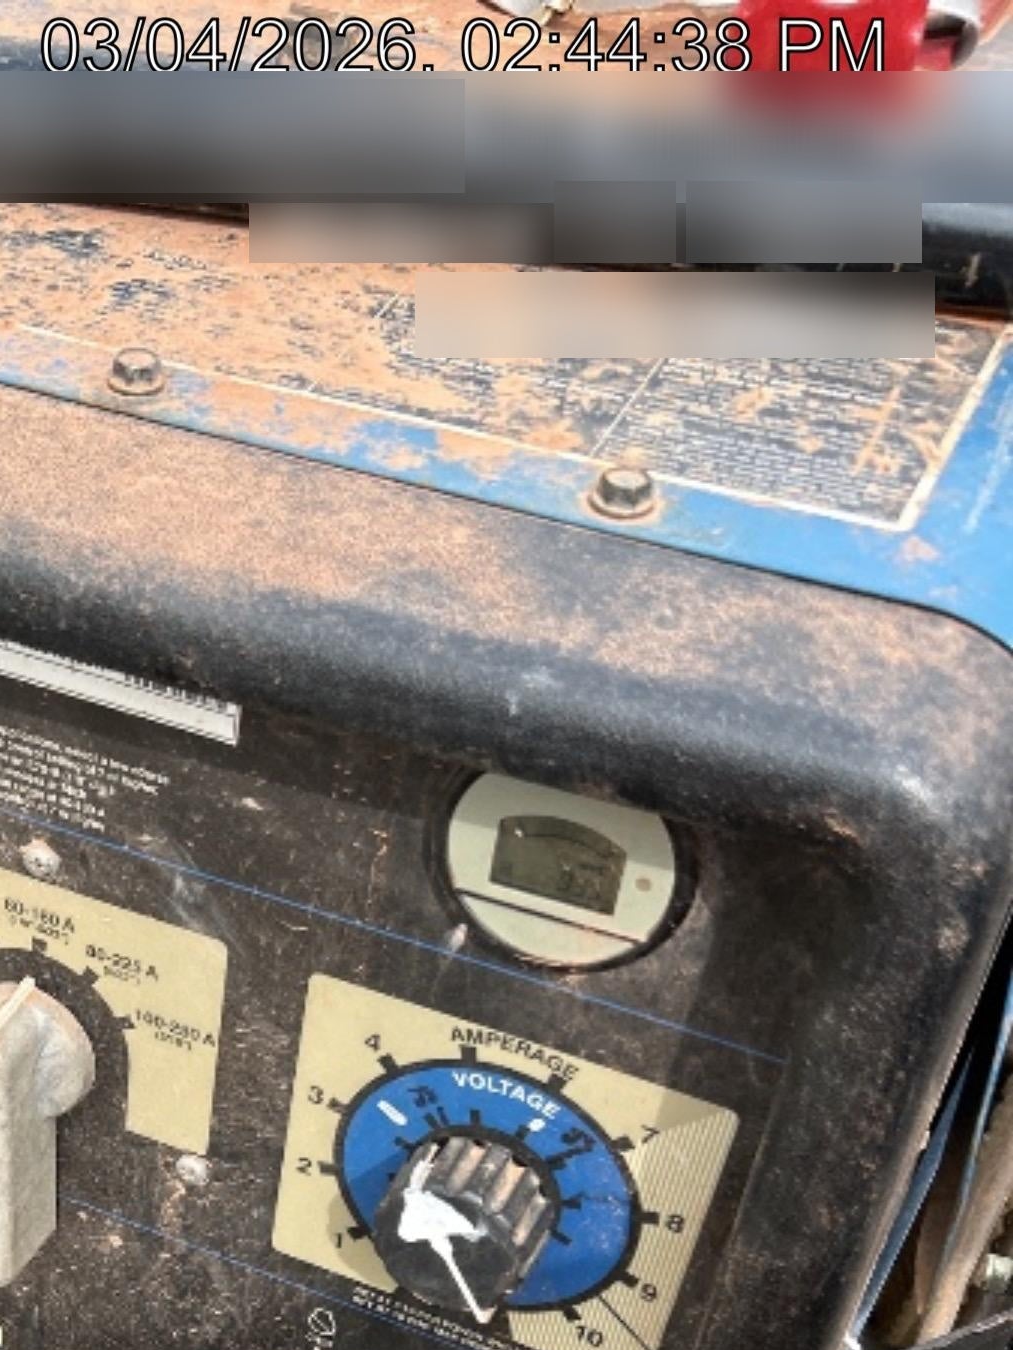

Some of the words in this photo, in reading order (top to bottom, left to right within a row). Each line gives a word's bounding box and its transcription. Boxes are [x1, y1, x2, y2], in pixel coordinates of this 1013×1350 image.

[62, 916, 75, 934] A
[145, 964, 159, 982] A
[202, 1032, 216, 1048] A
[364, 1033, 380, 1052] 4
[451, 1026, 579, 1081] AMPERAGE
[308, 1085, 323, 1104] 3
[451, 1070, 562, 1121] VOLTAGE
[641, 1124, 659, 1144] 7
[295, 1157, 312, 1176] 2
[667, 1213, 684, 1233] 8
[641, 1283, 658, 1302] 9
[575, 1325, 603, 1348] 10
